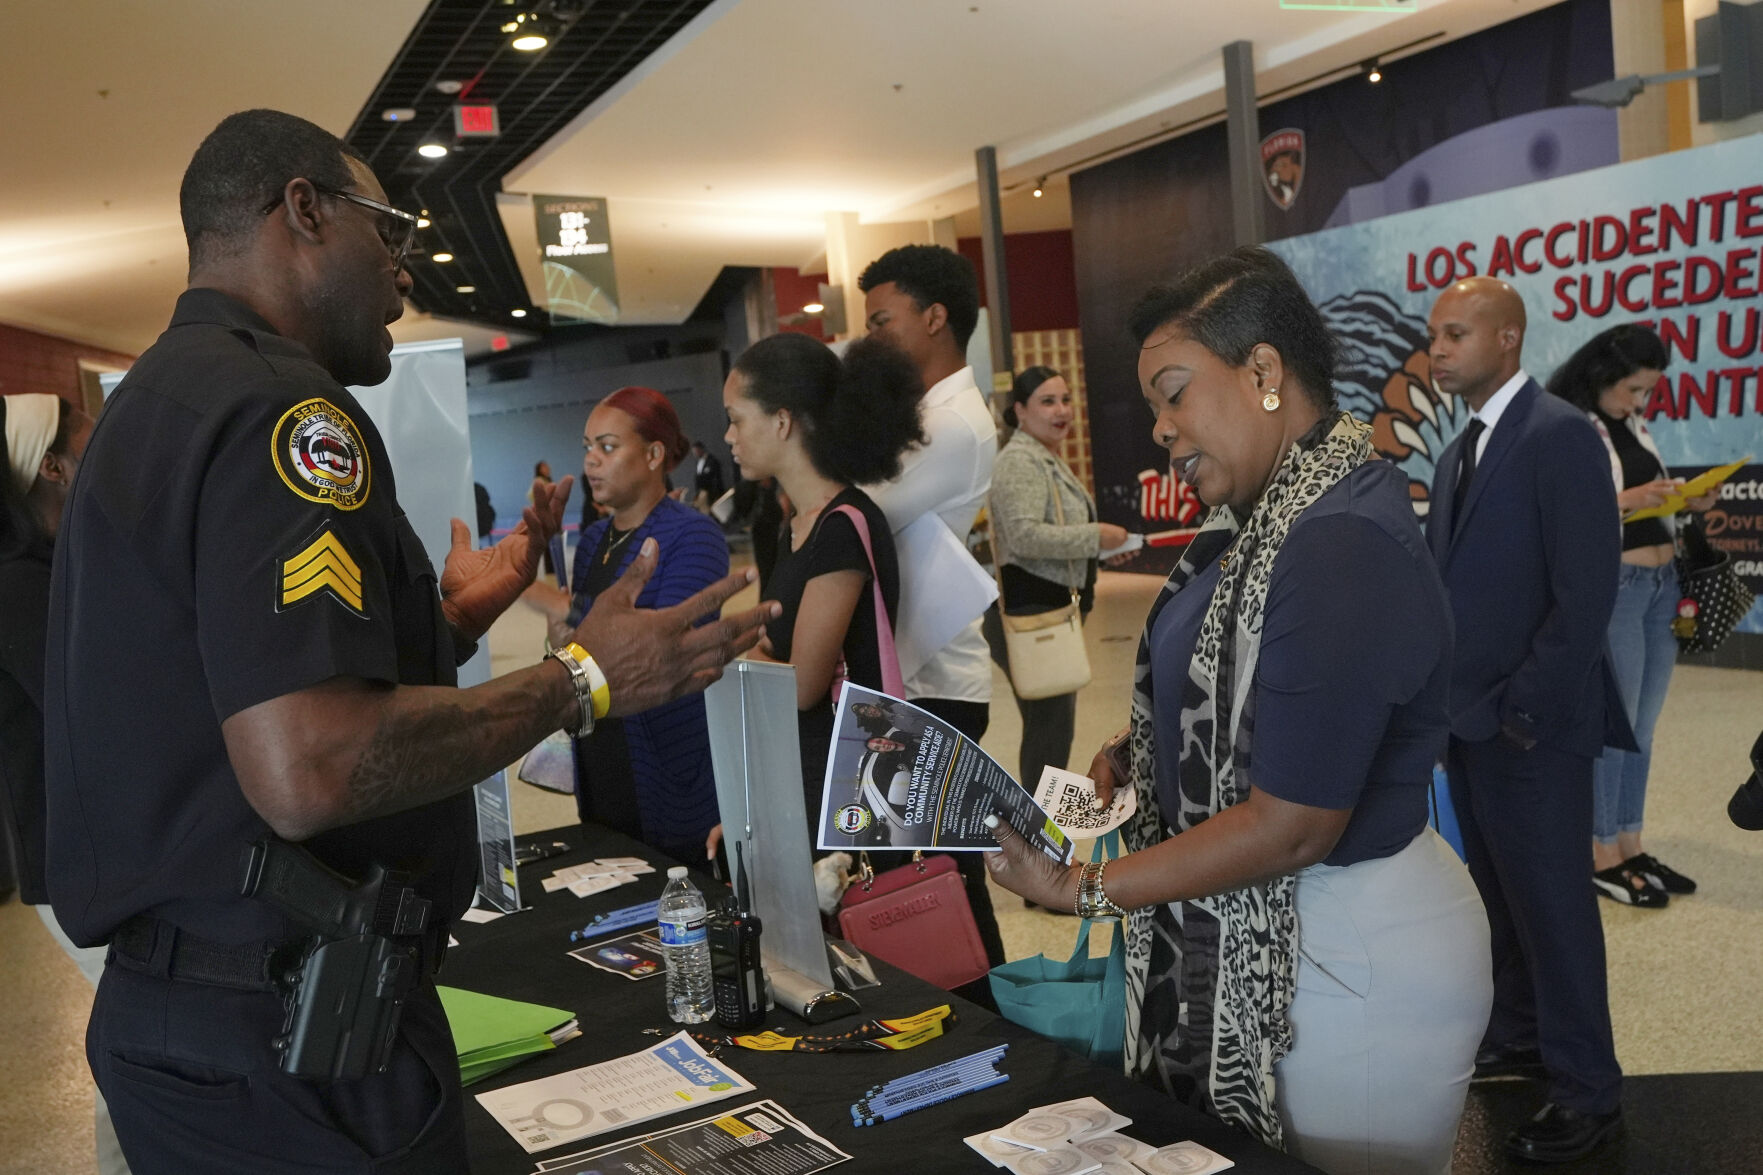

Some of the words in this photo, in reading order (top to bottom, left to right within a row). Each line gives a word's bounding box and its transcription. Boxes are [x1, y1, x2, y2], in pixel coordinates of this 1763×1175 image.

[1406, 241, 1478, 293] LOS
[1552, 248, 1763, 322] SUCEDE
[293, 403, 349, 429] SEMINOLE
[292, 418, 314, 449] SEMINOLE
[318, 488, 357, 506] POLICE
[920, 736, 930, 755] APPLY
[916, 755, 925, 765] TO
[911, 766, 922, 790] WANT
[914, 770, 931, 823] COMMUNITY
[927, 744, 939, 770] SERVICE
[1046, 776, 1059, 797] TEAM!
[907, 790, 917, 810] YOU
[904, 812, 913, 826] DO
[926, 807, 934, 822] WITH
